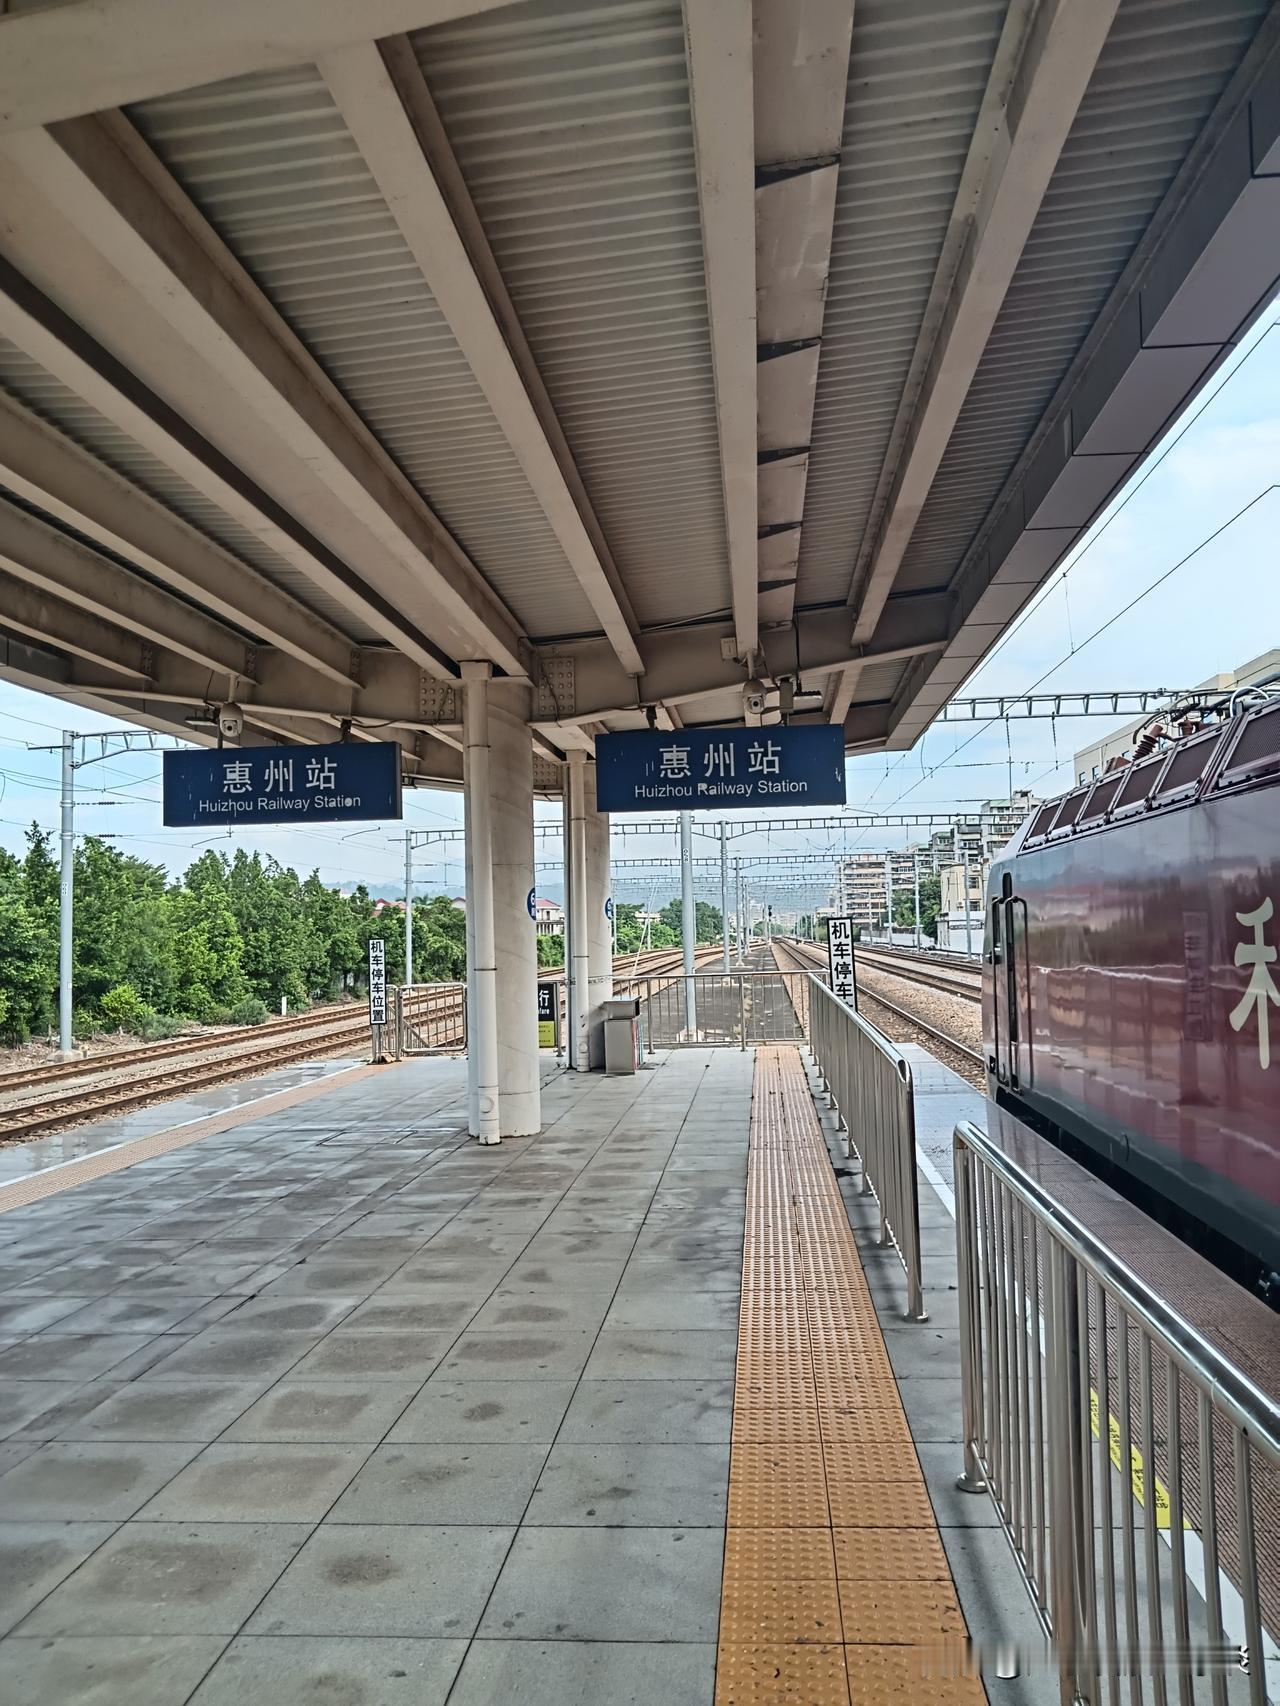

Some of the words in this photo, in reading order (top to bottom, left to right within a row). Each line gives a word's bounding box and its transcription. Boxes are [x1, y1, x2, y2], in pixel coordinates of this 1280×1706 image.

[222, 757, 338, 794] 惠州站
[659, 740, 782, 779] 惠州站
[199, 799, 253, 813] Huizhou
[257, 796, 310, 813] Railway
[314, 795, 361, 809] Station
[634, 784, 693, 799] Huizhou
[697, 782, 754, 798] Railway
[757, 779, 808, 794] Station
[370, 941, 385, 1022] 机车停车位置
[831, 921, 854, 1008] 机车停车
